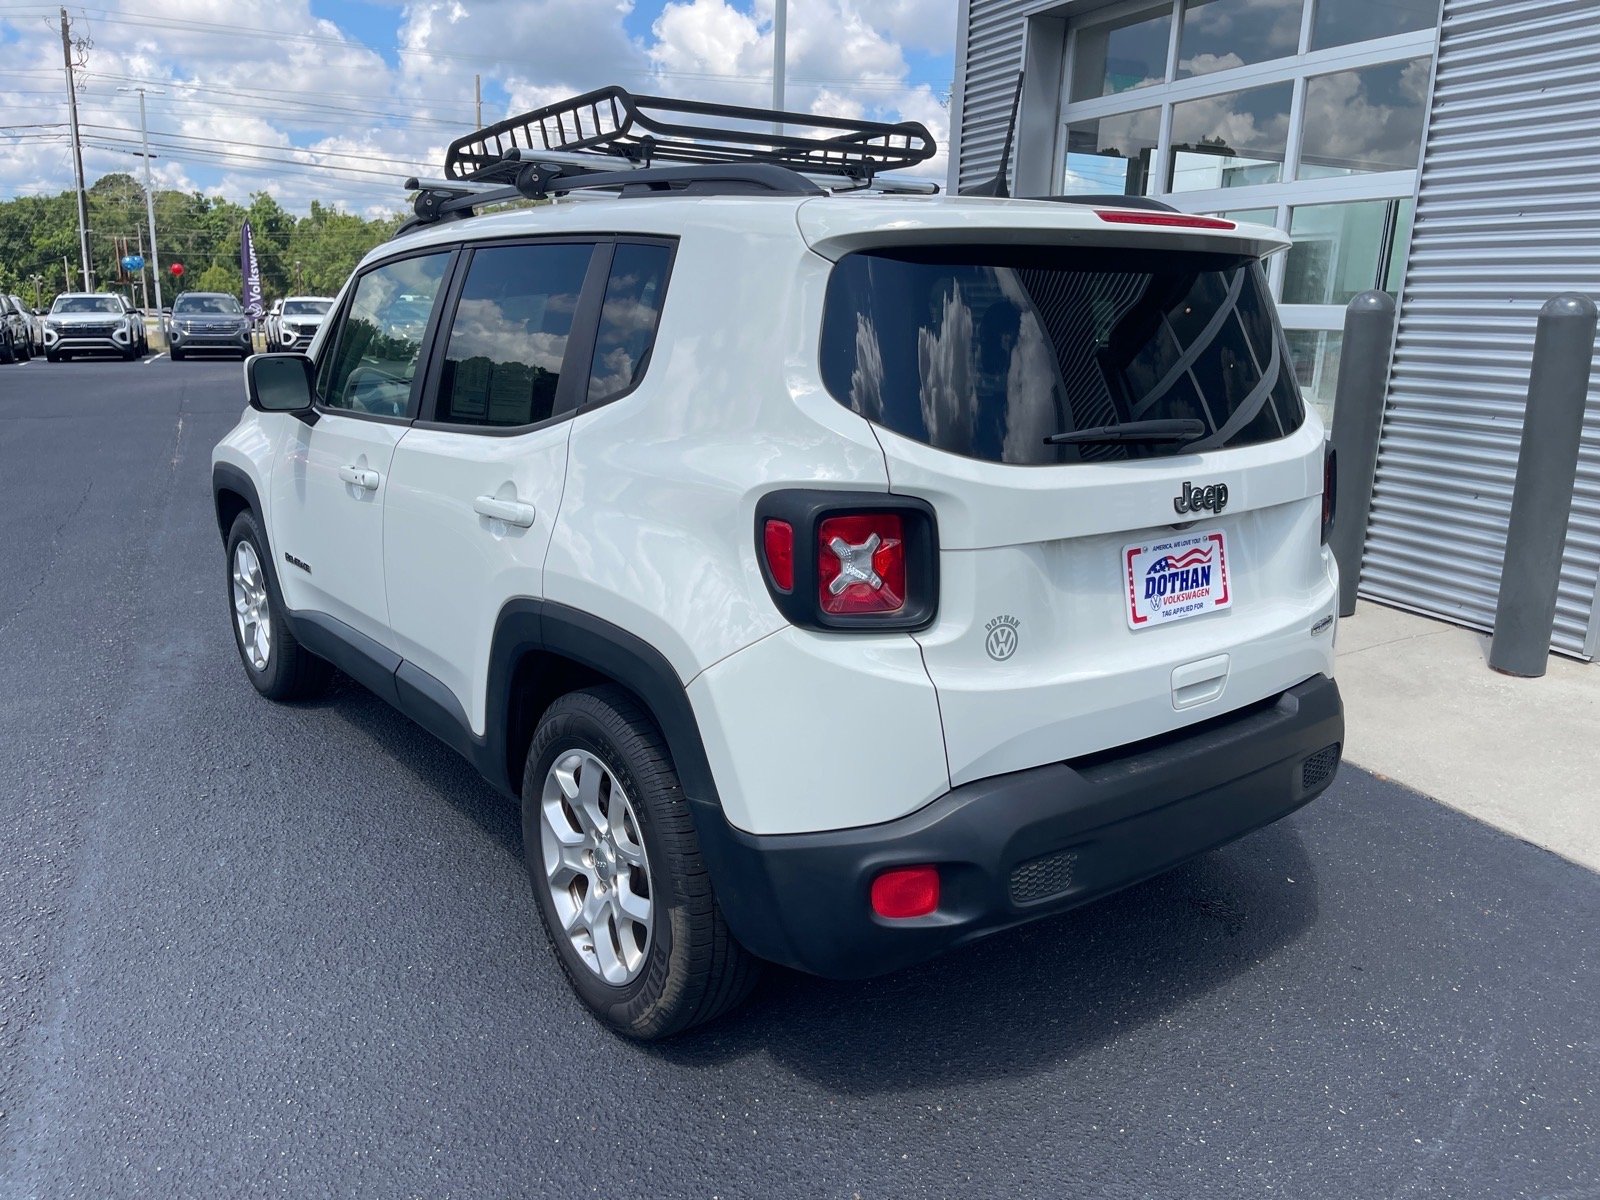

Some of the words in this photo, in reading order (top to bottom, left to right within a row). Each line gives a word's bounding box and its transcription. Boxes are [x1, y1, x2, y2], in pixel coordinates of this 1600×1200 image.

[1174, 481, 1228, 514] Jeep
[1153, 543, 1173, 552] AMERICA,
[1181, 539, 1191, 547] LOVE
[1144, 565, 1212, 600] DOTHAN
[1163, 587, 1210, 606] VOLKSWAGEN
[1162, 609, 1172, 618] TAG
[1172, 604, 1193, 615] APPLIED
[1194, 602, 1204, 610] FOR
[985, 615, 1020, 631] DOTHAN
